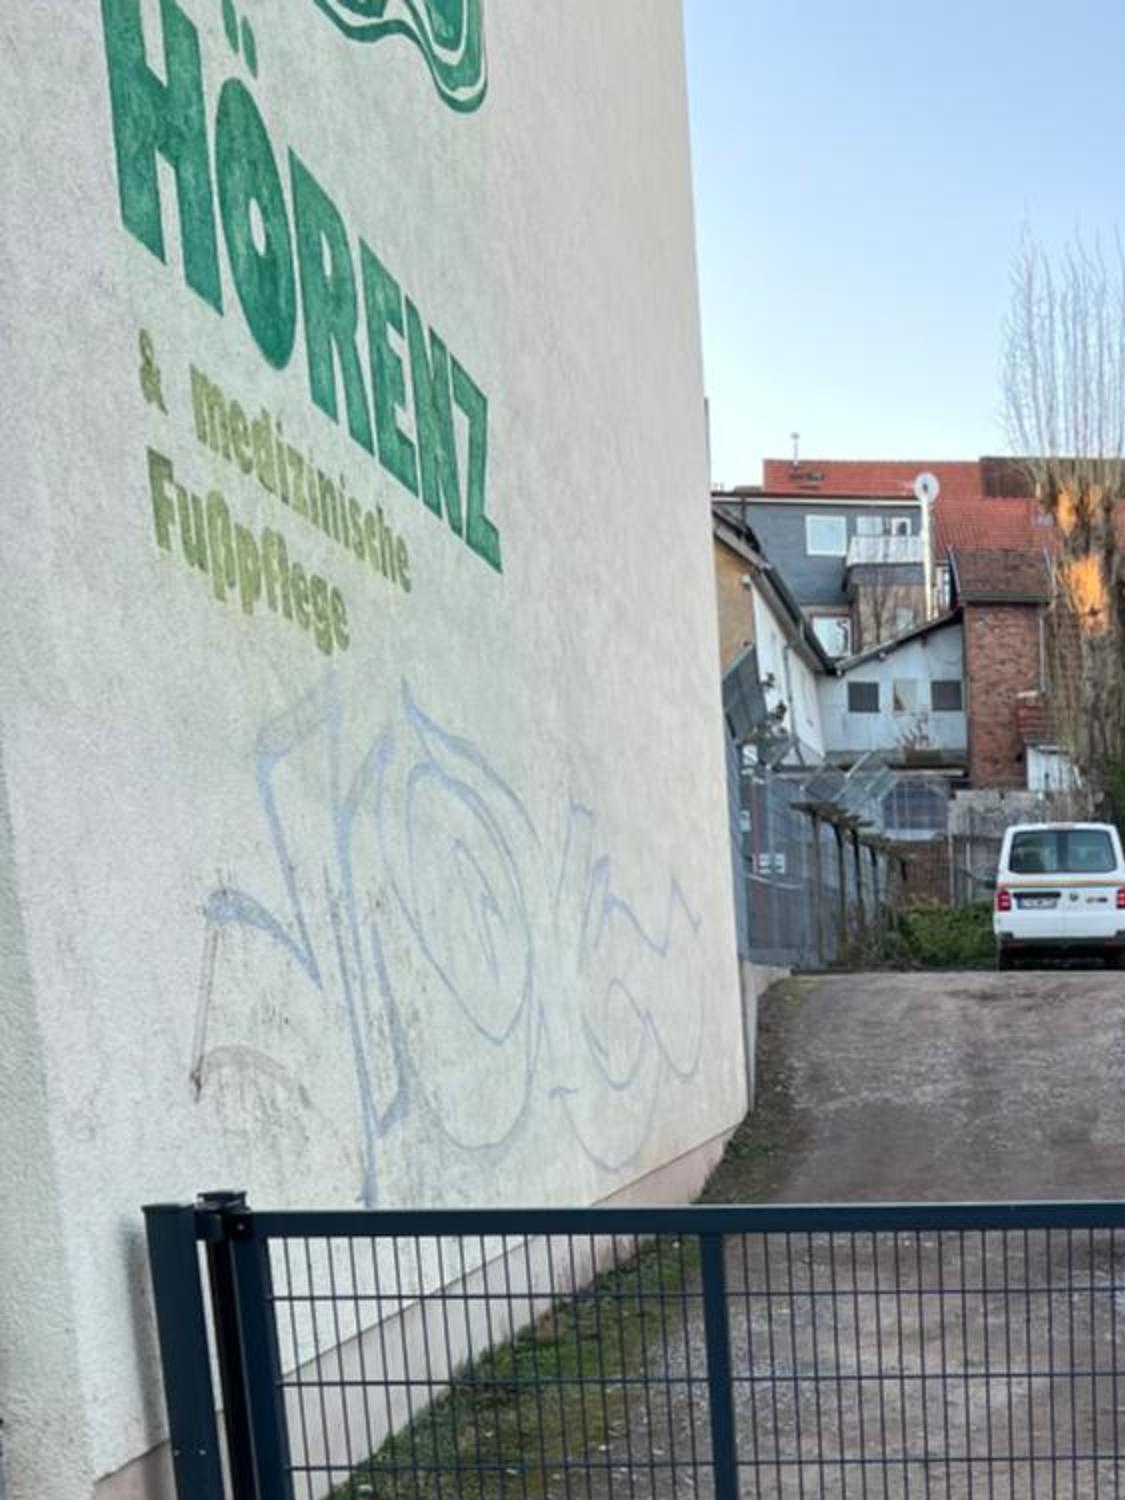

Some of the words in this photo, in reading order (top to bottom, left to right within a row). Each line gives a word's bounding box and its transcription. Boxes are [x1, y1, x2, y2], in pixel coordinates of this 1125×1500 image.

[102, 0, 503, 575] HÖRENZ
[139, 328, 169, 416] &
[189, 362, 412, 593] medizinische
[146, 445, 351, 656] Fußpflege
